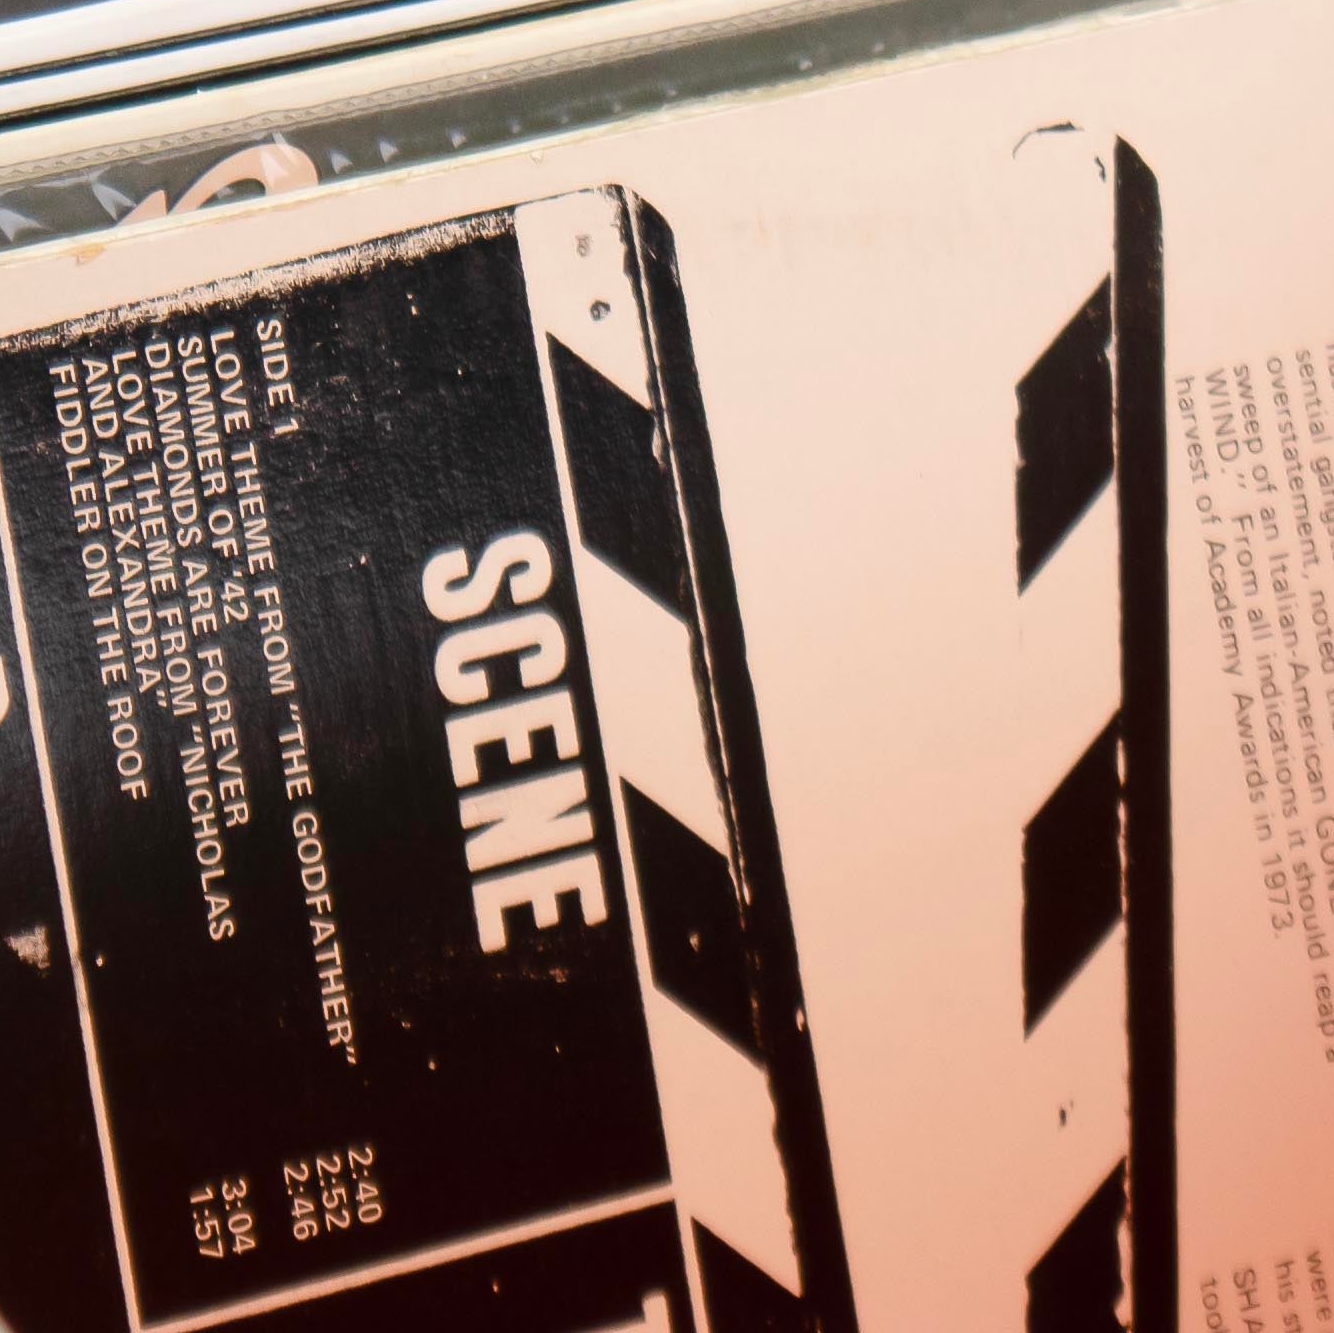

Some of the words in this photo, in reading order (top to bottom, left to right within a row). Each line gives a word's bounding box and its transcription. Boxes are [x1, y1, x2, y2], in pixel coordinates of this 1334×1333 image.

[81, 357, 119, 438] AND
[255, 318, 294, 406] SIDE
[1294, 348, 1332, 444] sential
[48, 362, 101, 532] FIDDLER
[143, 341, 202, 547] DIAMONDS
[176, 335, 227, 497] SUMMER
[207, 507, 238, 557] OF
[273, 416, 299, 435] 1
[1175, 374, 1210, 483] harvest
[1232, 363, 1263, 455] sweep
[1195, 493, 1222, 525] of
[1251, 463, 1278, 493] of
[1265, 355, 1320, 579] overstatement,
[111, 349, 152, 454] LOVE
[132, 460, 176, 594] THEME
[155, 605, 197, 715] FROM
[209, 329, 250, 433] LOVE
[230, 440, 274, 574] THEME
[253, 584, 295, 694] FROM
[1259, 505, 1279, 541] an
[81, 541, 112, 597] ON
[1230, 512, 1259, 597] From
[181, 560, 217, 636] ARE
[1203, 538, 1243, 676] Academy
[1246, 607, 1273, 641] all
[92, 605, 127, 685] THE
[1268, 551, 1327, 804] Italian-American
[106, 695, 147, 800] ROOF
[196, 646, 249, 827] FOREVER
[422, 532, 606, 951] SCENE
[1230, 692, 1269, 803] Awards
[1255, 652, 1299, 819] indications
[1253, 812, 1274, 842] in
[1286, 828, 1306, 850] it
[1261, 853, 1295, 938] 1973.
[1292, 860, 1330, 961] should
[189, 1186, 224, 1257] 1:57
[221, 1178, 255, 1254] 3:04
[283, 1162, 318, 1240] 2:46
[315, 1154, 350, 1231] 2:52
[347, 1146, 382, 1223] 2:40
[1273, 1257, 1295, 1303] his
[1305, 1248, 1332, 1321] were
